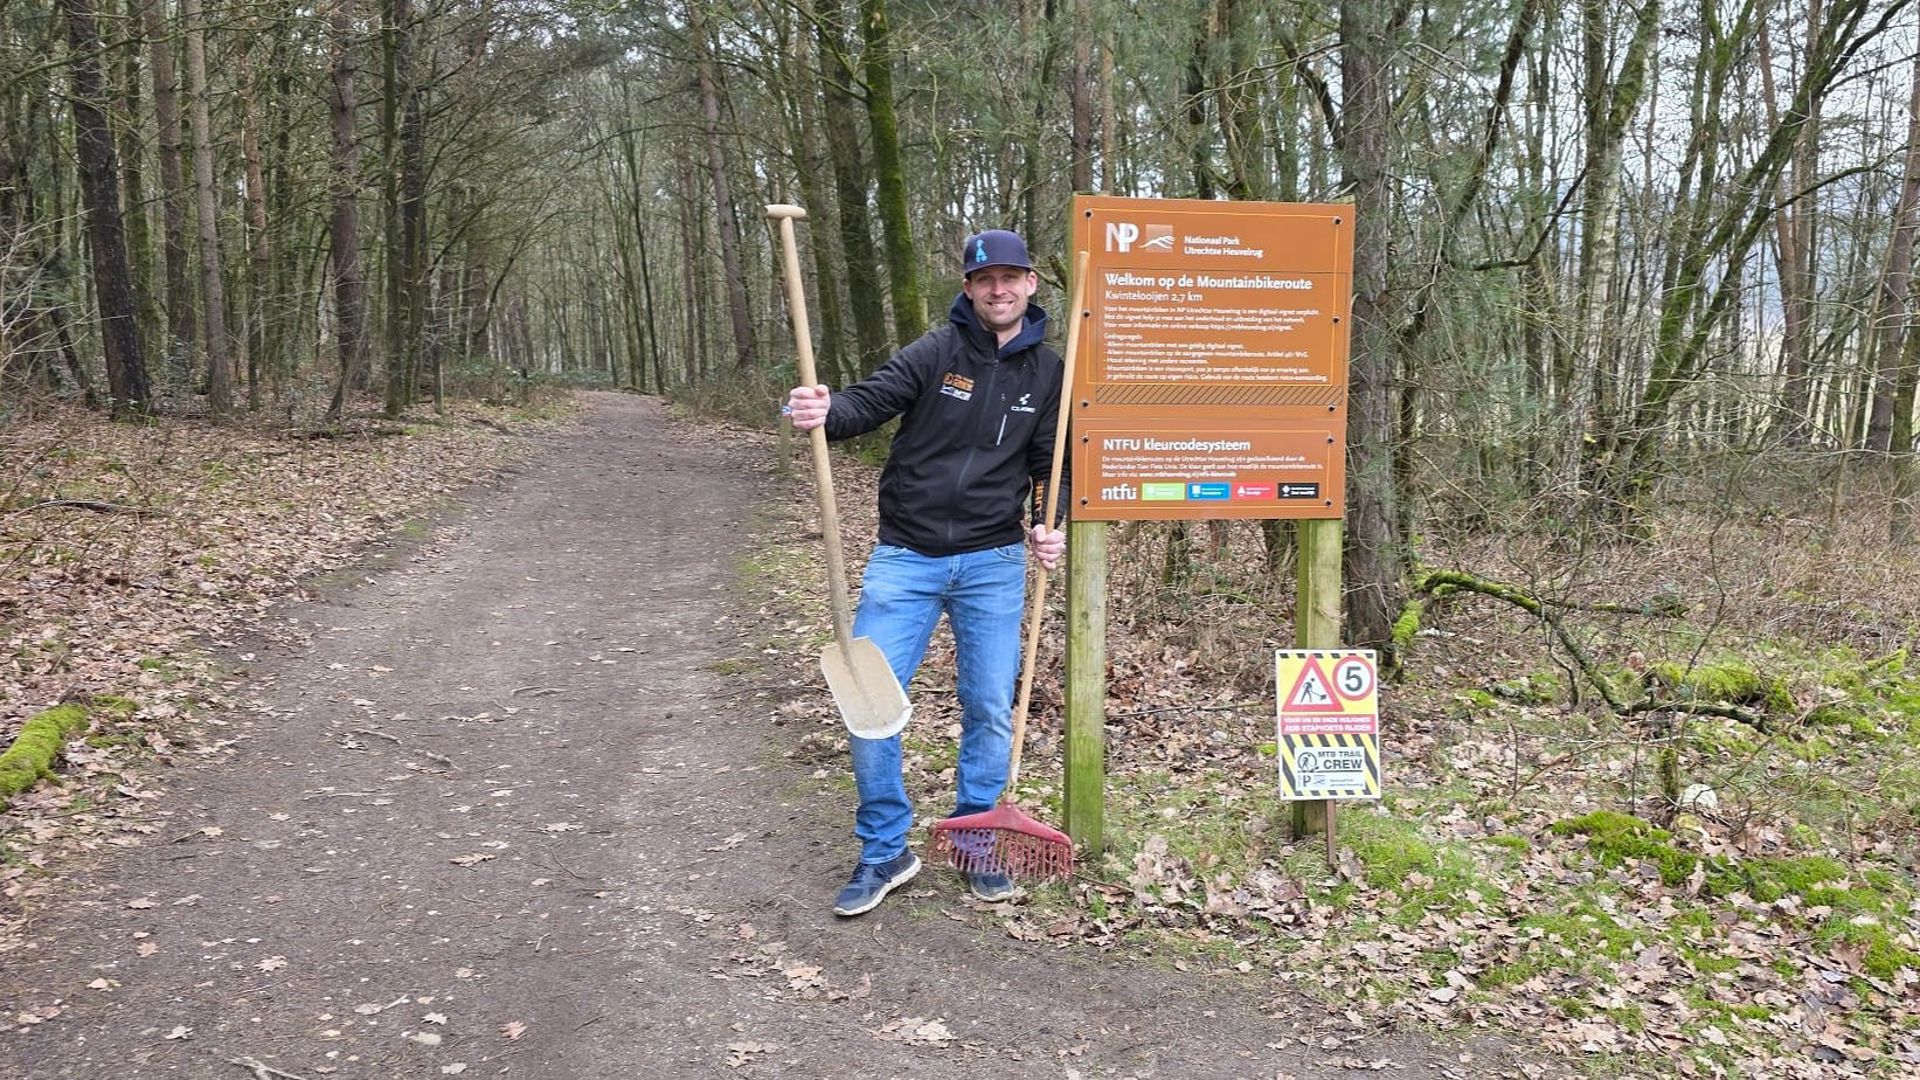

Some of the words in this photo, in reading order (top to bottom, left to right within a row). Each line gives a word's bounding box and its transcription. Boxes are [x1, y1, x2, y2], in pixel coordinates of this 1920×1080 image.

[1105, 222, 1139, 252] NP
[1184, 236, 1221, 245] Nationaal
[1223, 237, 1240, 245] Park
[1184, 246, 1221, 255] Utrechtse
[1223, 247, 1264, 258] Heuvelrug
[1105, 273, 1155, 286] Welkom
[1158, 277, 1175, 290] op
[1178, 275, 1194, 287] de
[1197, 275, 1313, 290] Mountainbikeroute
[1105, 290, 1169, 302] Kwintelooijen
[1188, 292, 1203, 301] km
[1103, 439, 1140, 451] NTFU
[1143, 438, 1251, 454] kleurcodesysteem
[1102, 483, 1137, 500] ntfu
[1345, 666, 1363, 692] 5
[1323, 759, 1363, 770] CREW
